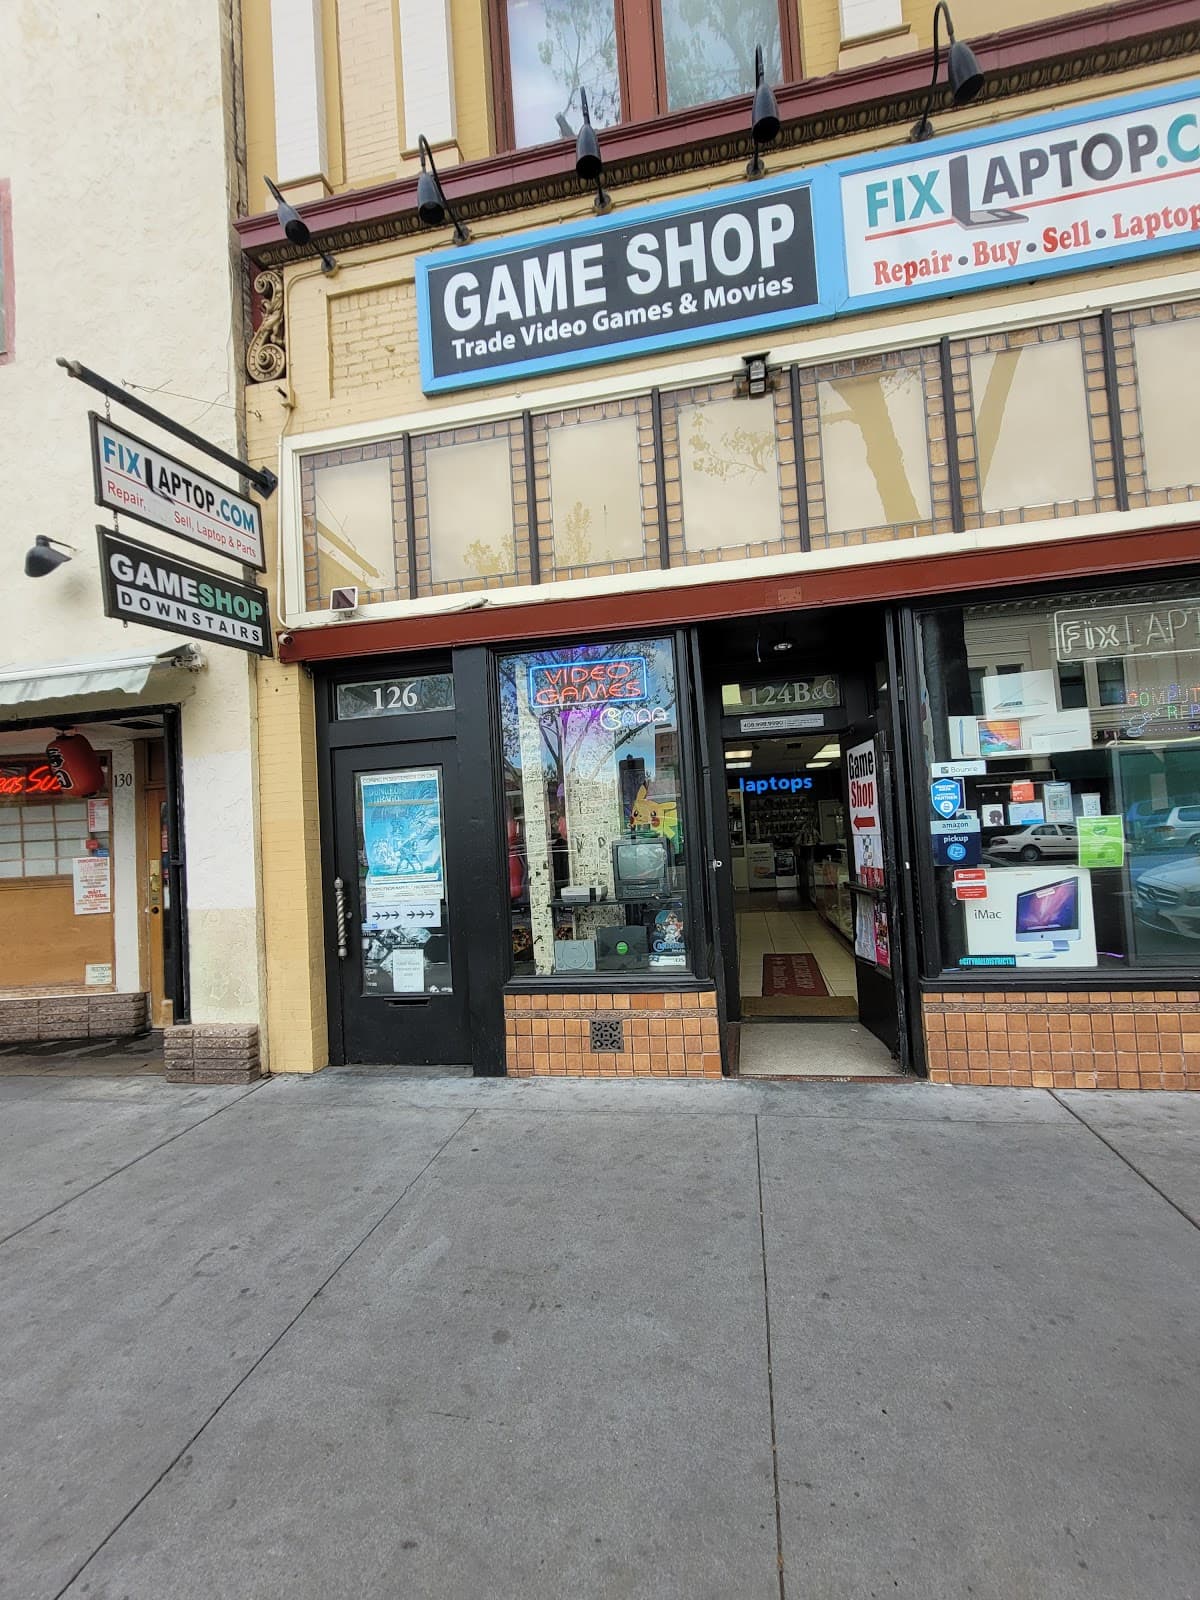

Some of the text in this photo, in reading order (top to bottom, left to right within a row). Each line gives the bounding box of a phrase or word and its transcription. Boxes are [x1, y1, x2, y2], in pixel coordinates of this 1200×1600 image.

[873, 250, 952, 286] Repair
[972, 238, 1022, 266] Buy
[1042, 220, 1092, 253] Sell
[444, 203, 795, 331] GAME SHOP
[451, 275, 794, 360] Trade Video Games & Movies
[197, 520, 227, 547] Laptop
[228, 535, 235, 548] &
[236, 537, 257, 558] Parts
[121, 591, 260, 642] DOWNSTAIRS
[546, 663, 631, 685] VIDEO
[372, 683, 418, 710] 126
[536, 679, 641, 705] GAMES
[849, 750, 874, 779] Game
[113, 773, 133, 787] 130
[739, 776, 813, 794] laptops
[851, 781, 873, 809] Shop
[942, 821, 969, 829] amazon
[943, 835, 969, 844] pickup
[973, 909, 1002, 920] iMac
